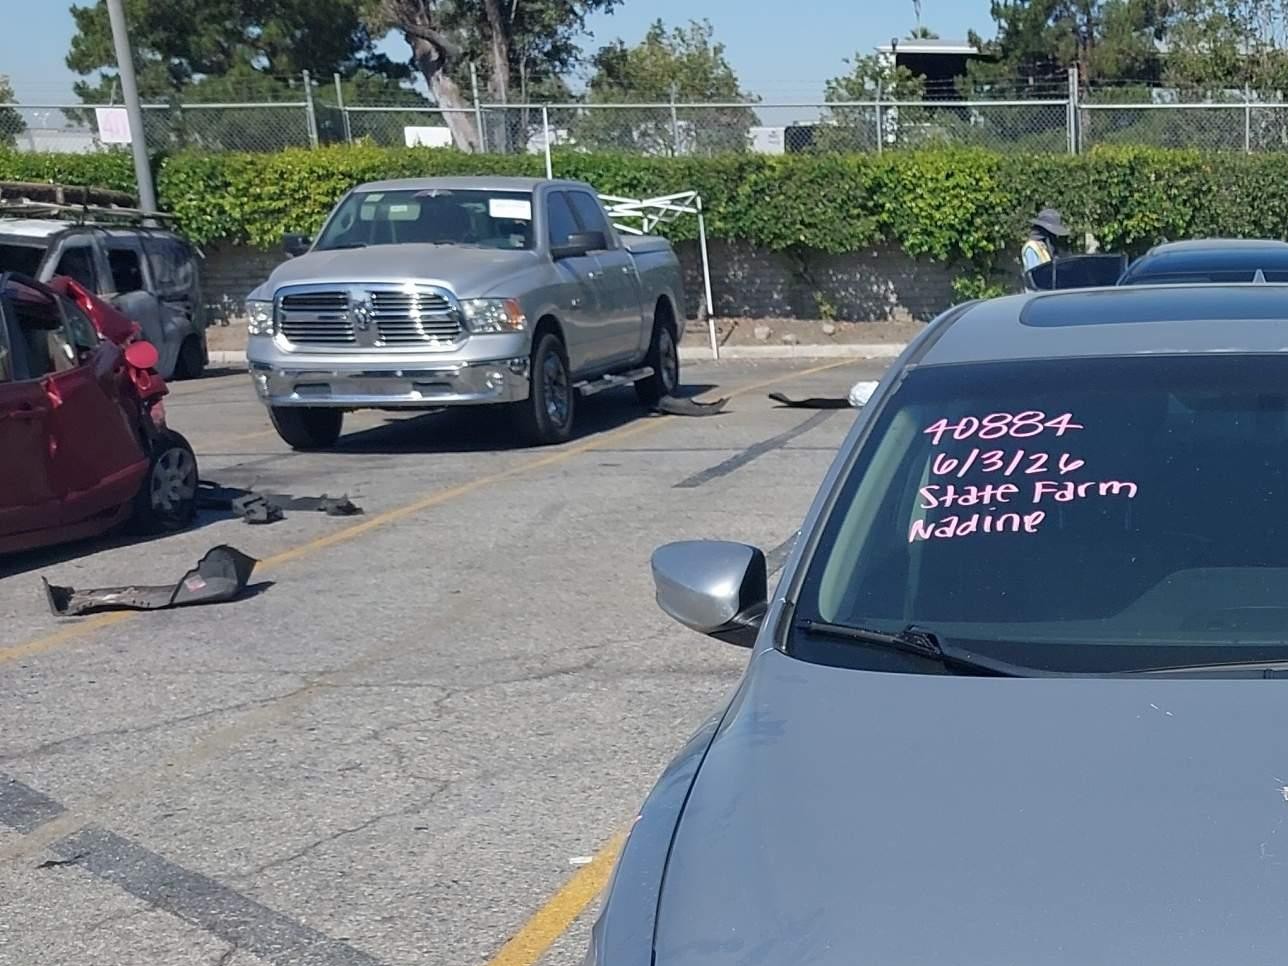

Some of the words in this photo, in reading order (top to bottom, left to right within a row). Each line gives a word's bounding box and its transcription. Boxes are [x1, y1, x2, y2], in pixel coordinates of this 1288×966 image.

[923, 411, 1084, 445] 40884
[932, 448, 1085, 478] 6/3/26
[919, 483, 1019, 509] State
[1032, 480, 1138, 503] Farm
[908, 506, 1046, 543] Nadine
